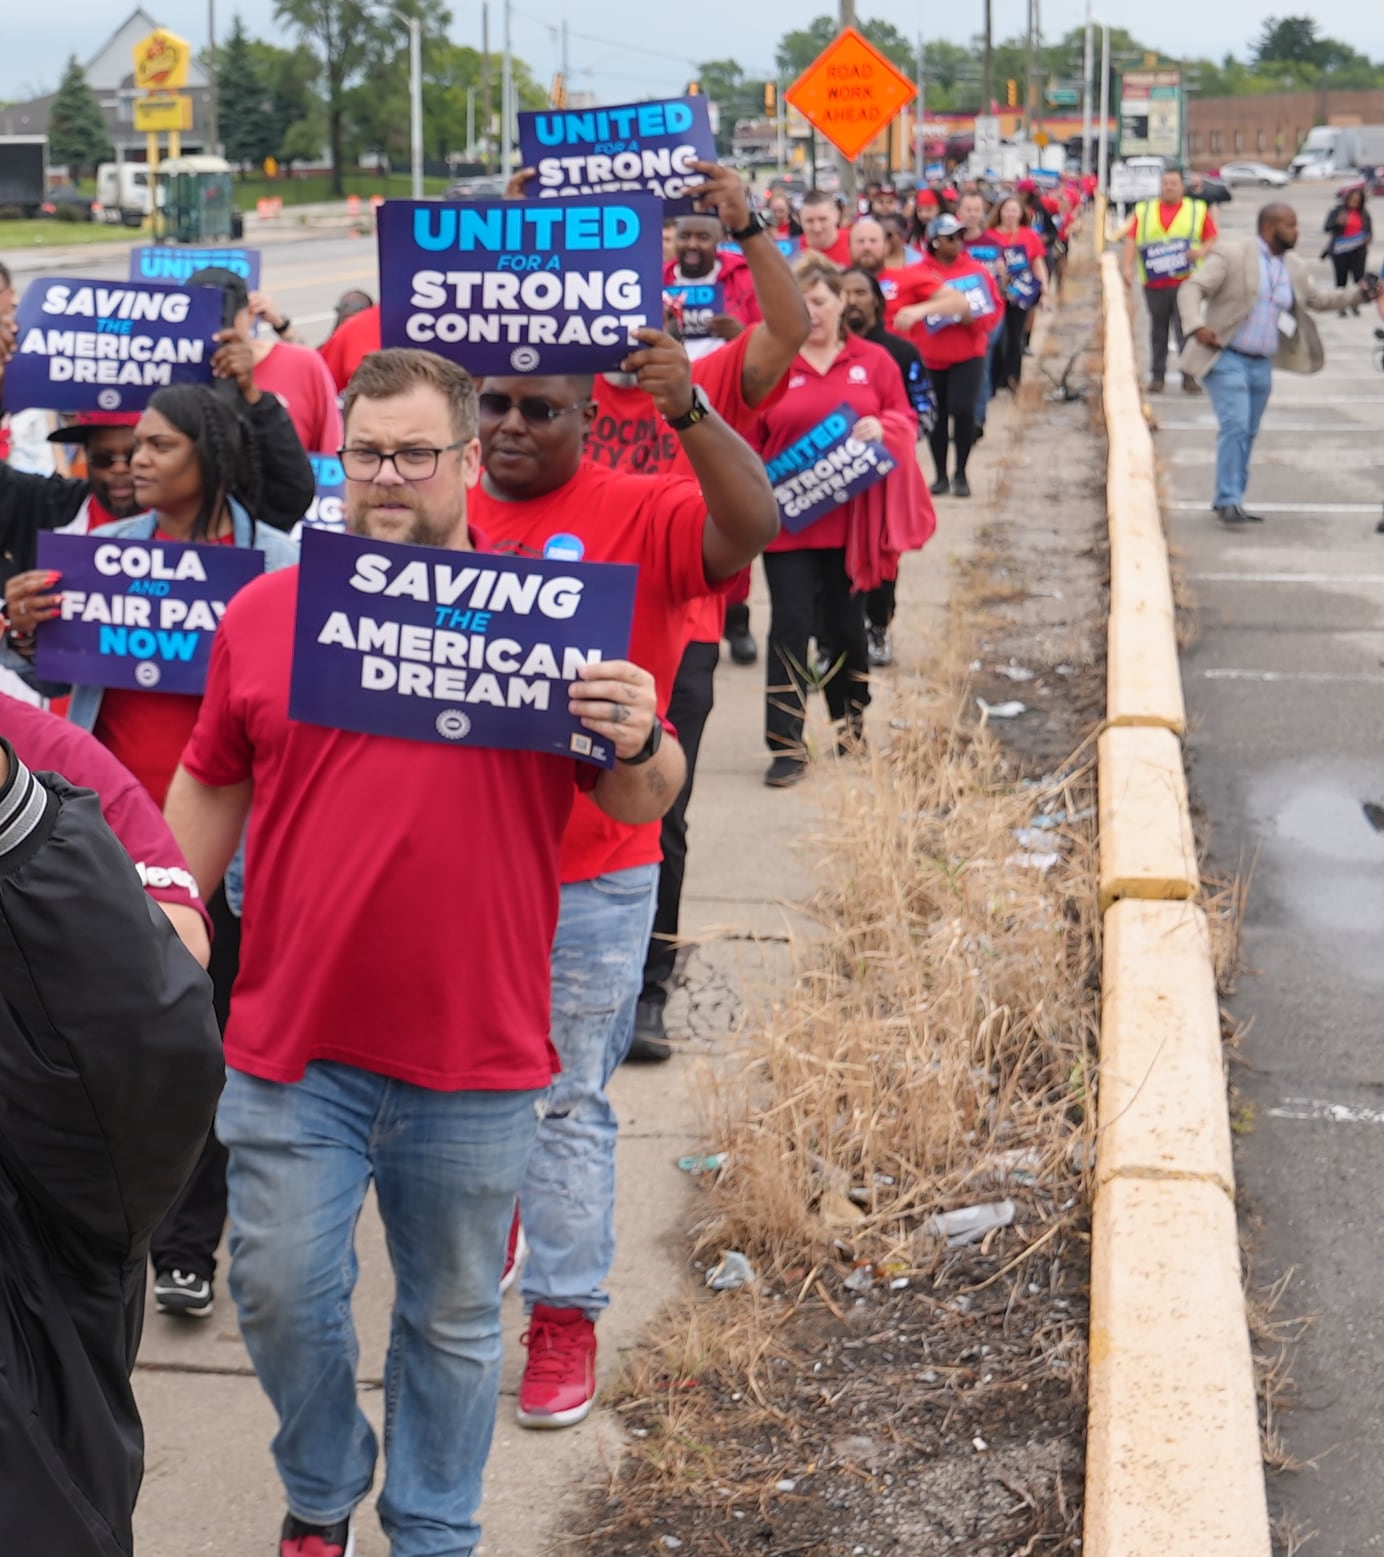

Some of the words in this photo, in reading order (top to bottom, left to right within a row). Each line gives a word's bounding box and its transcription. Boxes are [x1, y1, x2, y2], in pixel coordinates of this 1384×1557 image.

[827, 64, 873, 80] ROAD
[827, 86, 873, 100] WORK
[535, 102, 694, 146] UNITED
[823, 105, 880, 123] AHEAD
[538, 145, 699, 187] STRONG
[413, 205, 642, 251] UNITED
[496, 254, 541, 272] FOR
[544, 254, 562, 272] A
[41, 285, 191, 323] SAVING
[410, 269, 643, 312] STRONG
[95, 317, 135, 335] THE
[405, 313, 648, 347] CONTRACT
[20, 329, 204, 364] AMERICAN
[48, 355, 173, 385] DREAM
[773, 437, 867, 505] STRONG
[784, 446, 878, 518] CONTRACT
[94, 544, 208, 581] COLA
[127, 580, 170, 597] AND
[349, 553, 585, 620] SAVING
[61, 590, 152, 628] FAIR
[434, 606, 492, 633] THE
[100, 626, 199, 662] NOW
[317, 611, 603, 680] AMERICAN
[361, 655, 551, 711] DREAM
